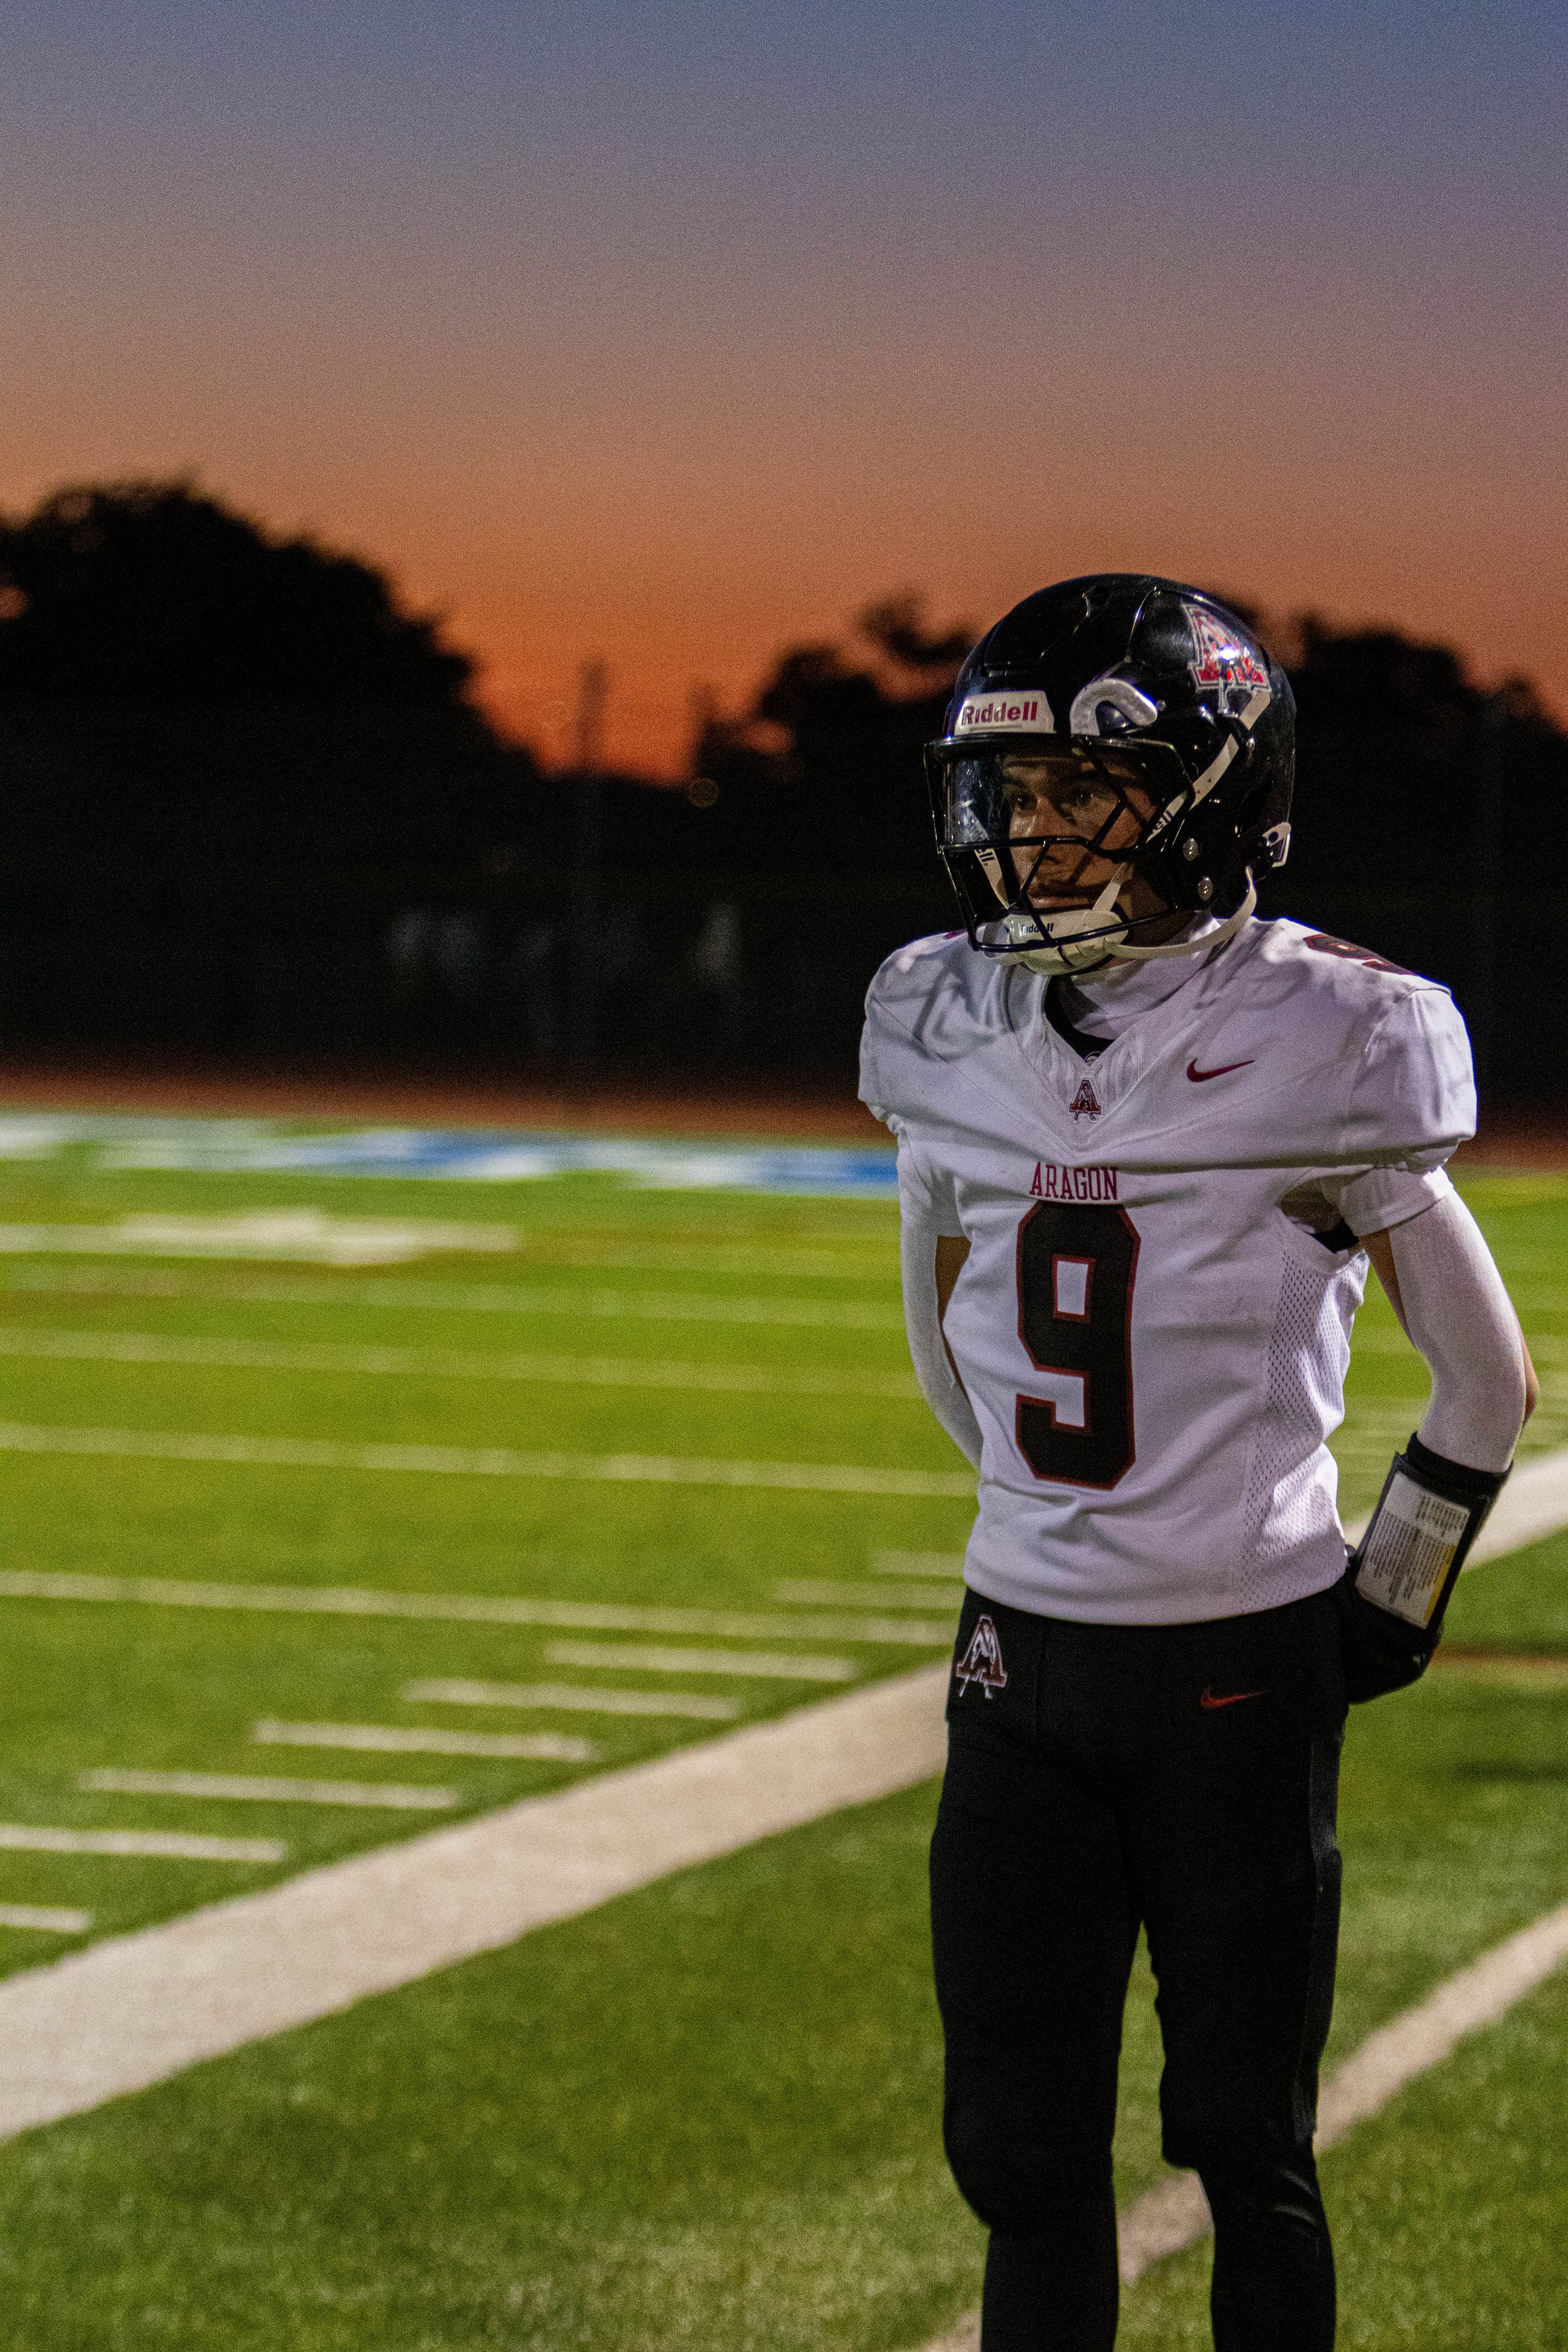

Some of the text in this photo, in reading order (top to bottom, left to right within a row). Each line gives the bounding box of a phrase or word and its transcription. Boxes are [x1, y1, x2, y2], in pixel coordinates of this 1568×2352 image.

[961, 701, 1038, 726] Riddell
[1029, 1162, 1119, 1200] ARAGON
[1015, 1199, 1142, 1492] 9
